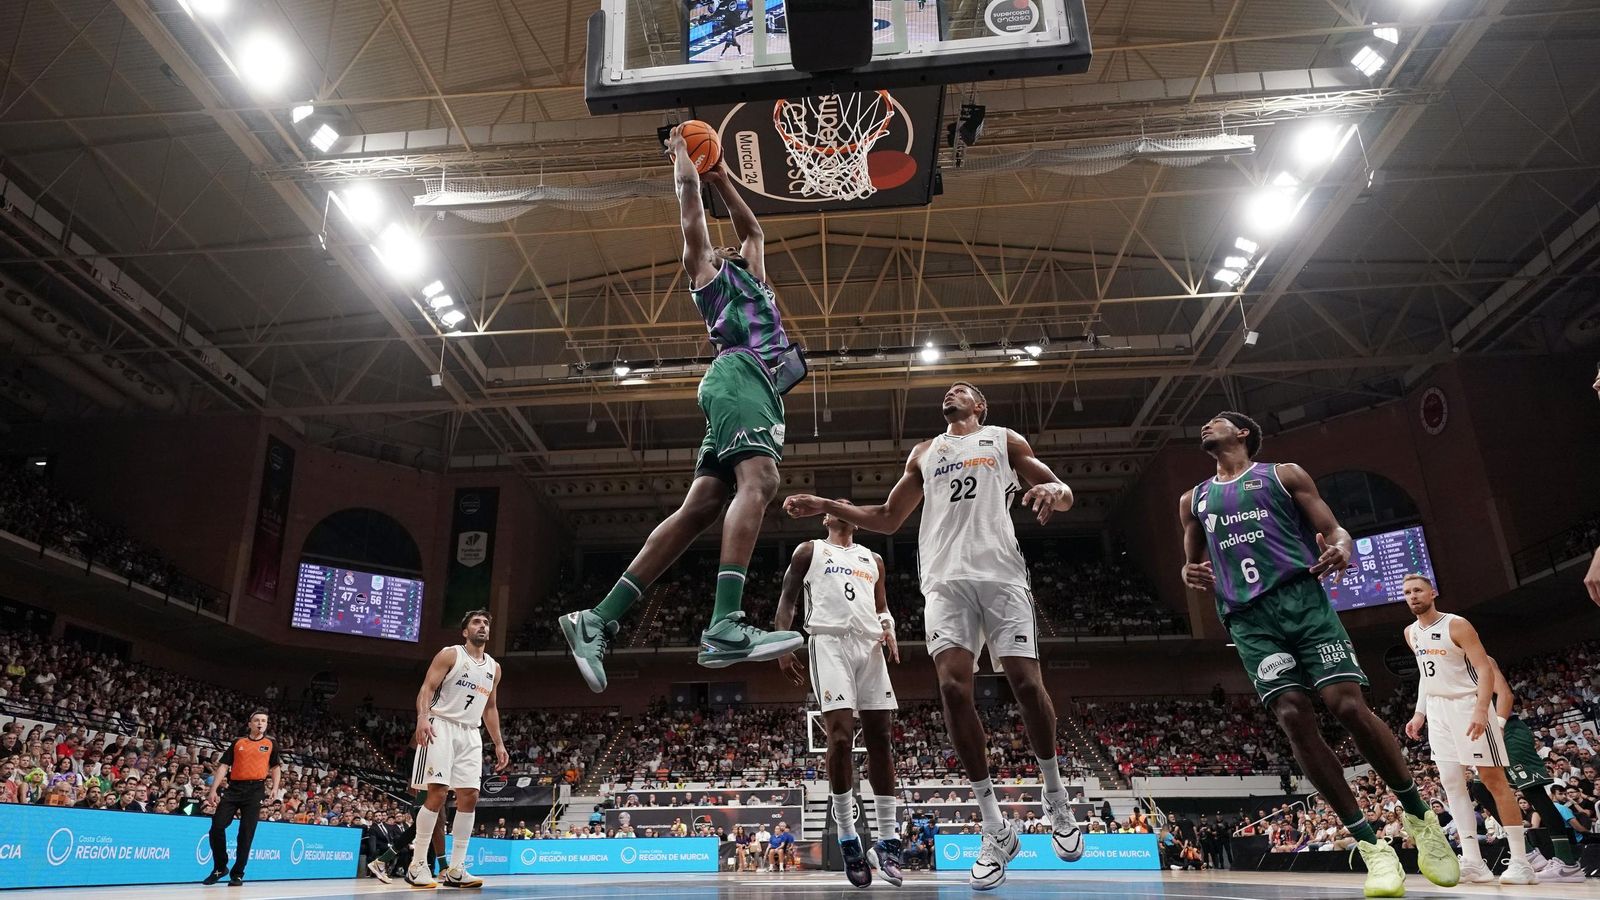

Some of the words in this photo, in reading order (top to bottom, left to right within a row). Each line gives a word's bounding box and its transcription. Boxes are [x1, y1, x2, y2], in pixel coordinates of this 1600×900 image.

[739, 134, 756, 169] Murcia
[745, 171, 758, 184] '24
[934, 457, 995, 477] AUTOHERO
[950, 477, 977, 502] 22
[1220, 507, 1269, 526] Unicaja
[1219, 528, 1265, 550] málaga
[1241, 557, 1260, 584] 6
[1362, 559, 1376, 571] 56
[824, 566, 873, 584] AUTOHERO
[1342, 574, 1366, 586] 5:11
[341, 592, 353, 602] 47
[370, 595, 382, 605] 56
[844, 582, 856, 602] 8
[350, 604, 370, 614] 5:11
[1320, 650, 1348, 664] laga
[1422, 660, 1436, 678] 13
[463, 694, 475, 710] 7
[75, 844, 117, 859] REGIÓN
[119, 846, 132, 859] DE
[134, 847, 170, 859] MURCIA
[254, 849, 281, 860] MURCIA
[325, 851, 334, 860] DE
[334, 851, 354, 861] MURCIA
[579, 854, 609, 862] MURCIA
[668, 853, 678, 861] DE
[680, 853, 709, 861] MURCIA
[1106, 850, 1117, 858] DE
[1119, 850, 1151, 858] MURCIA
